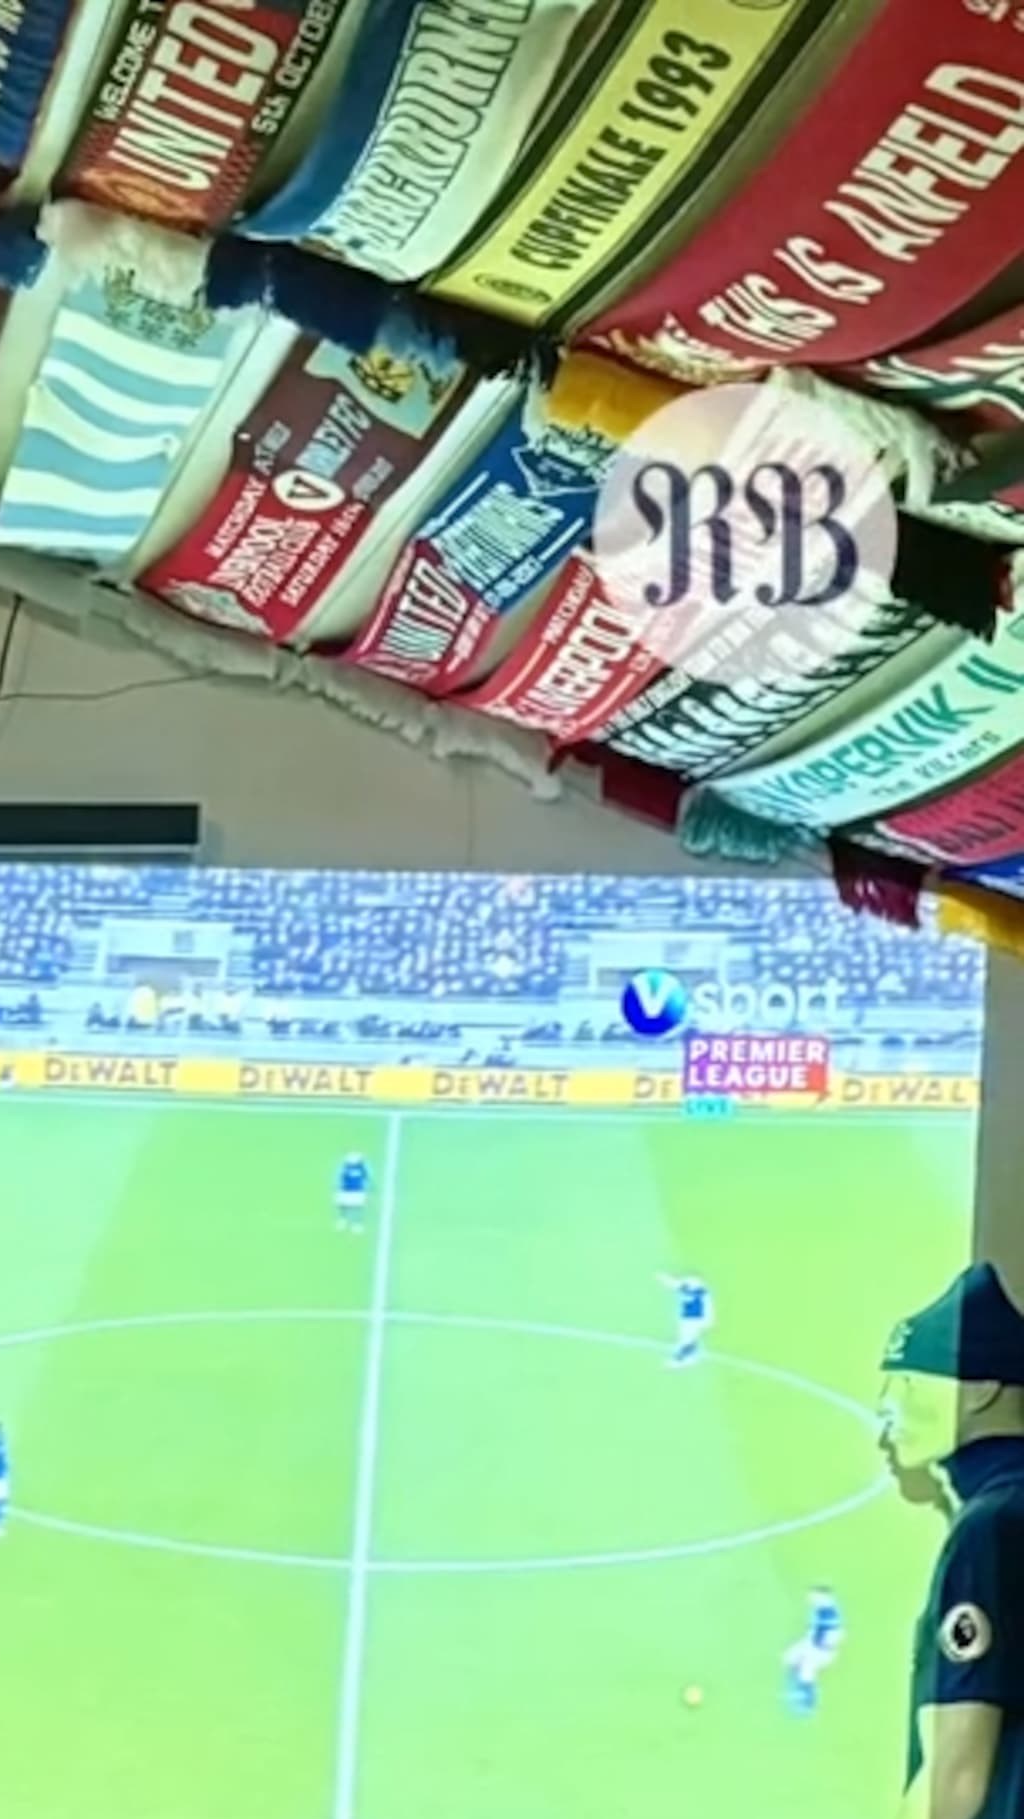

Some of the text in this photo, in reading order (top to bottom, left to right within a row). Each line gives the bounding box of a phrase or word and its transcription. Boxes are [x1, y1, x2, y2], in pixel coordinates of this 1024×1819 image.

[92, 20, 157, 121] WELCOME
[275, 0, 341, 89] OCTOB
[107, 1, 280, 190] UNITED
[510, 125, 669, 270] CUPFINALE
[619, 29, 732, 133] 1993
[697, 62, 1024, 353] THIS IS ANFIELD
[287, 475, 331, 502] V
[694, 976, 845, 1029] sport
[688, 1040, 829, 1064] PREMIER
[688, 1065, 809, 1089] LEAGUE
[841, 1078, 980, 1104] DEWAL
